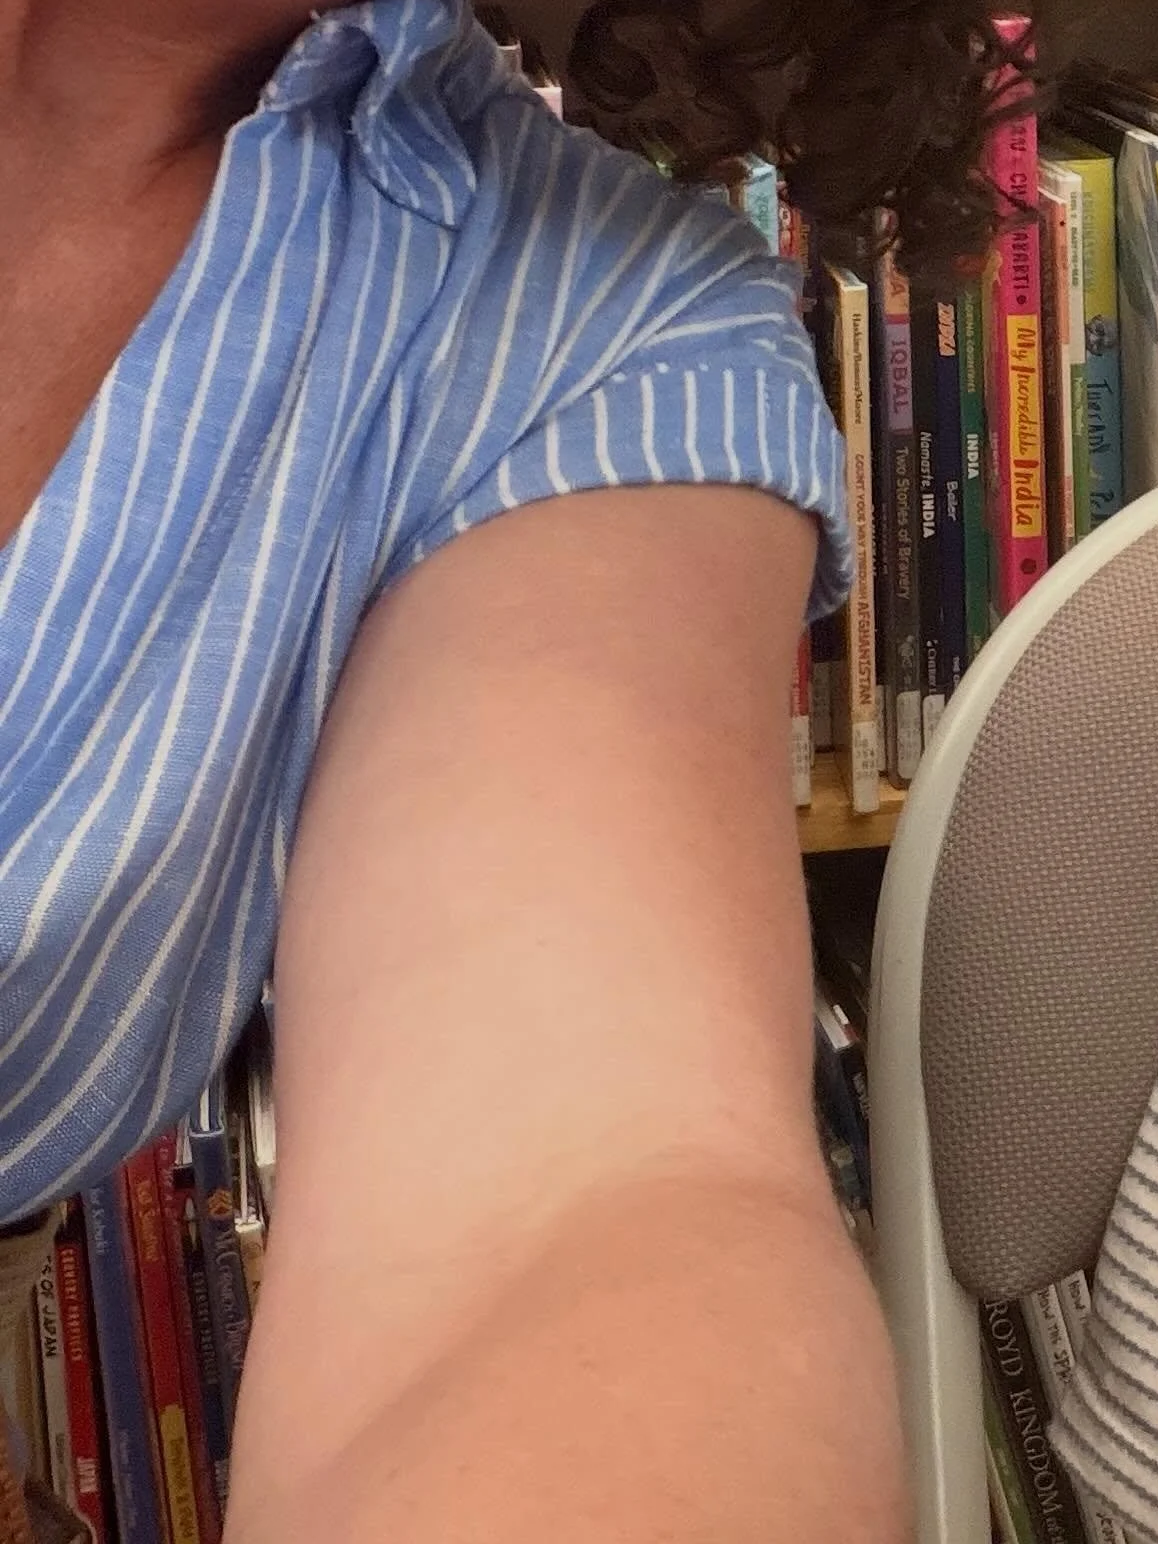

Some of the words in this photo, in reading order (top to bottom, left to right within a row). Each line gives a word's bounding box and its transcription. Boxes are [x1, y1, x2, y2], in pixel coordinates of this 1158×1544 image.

[1009, 325, 1036, 360] My
[889, 338, 909, 414] IQBAL
[1009, 362, 1039, 456] Incredible
[853, 453, 865, 490] COUNT
[894, 446, 909, 474] Two
[962, 431, 982, 480] INDIA
[854, 493, 866, 522] YOUR
[895, 478, 911, 525] Stories
[918, 492, 936, 538] INDIA
[1012, 457, 1041, 527] India
[855, 524, 866, 547] WAY
[898, 528, 912, 543] of
[855, 549, 868, 599] THROUGH
[894, 546, 914, 600] Bravery
[855, 601, 873, 705] AFGHANISTAN
[39, 1278, 54, 1299] OF
[1067, 1280, 1089, 1311] HOW
[41, 1303, 59, 1358] JAPAN
[1010, 1390, 1064, 1514] KINGDOM
